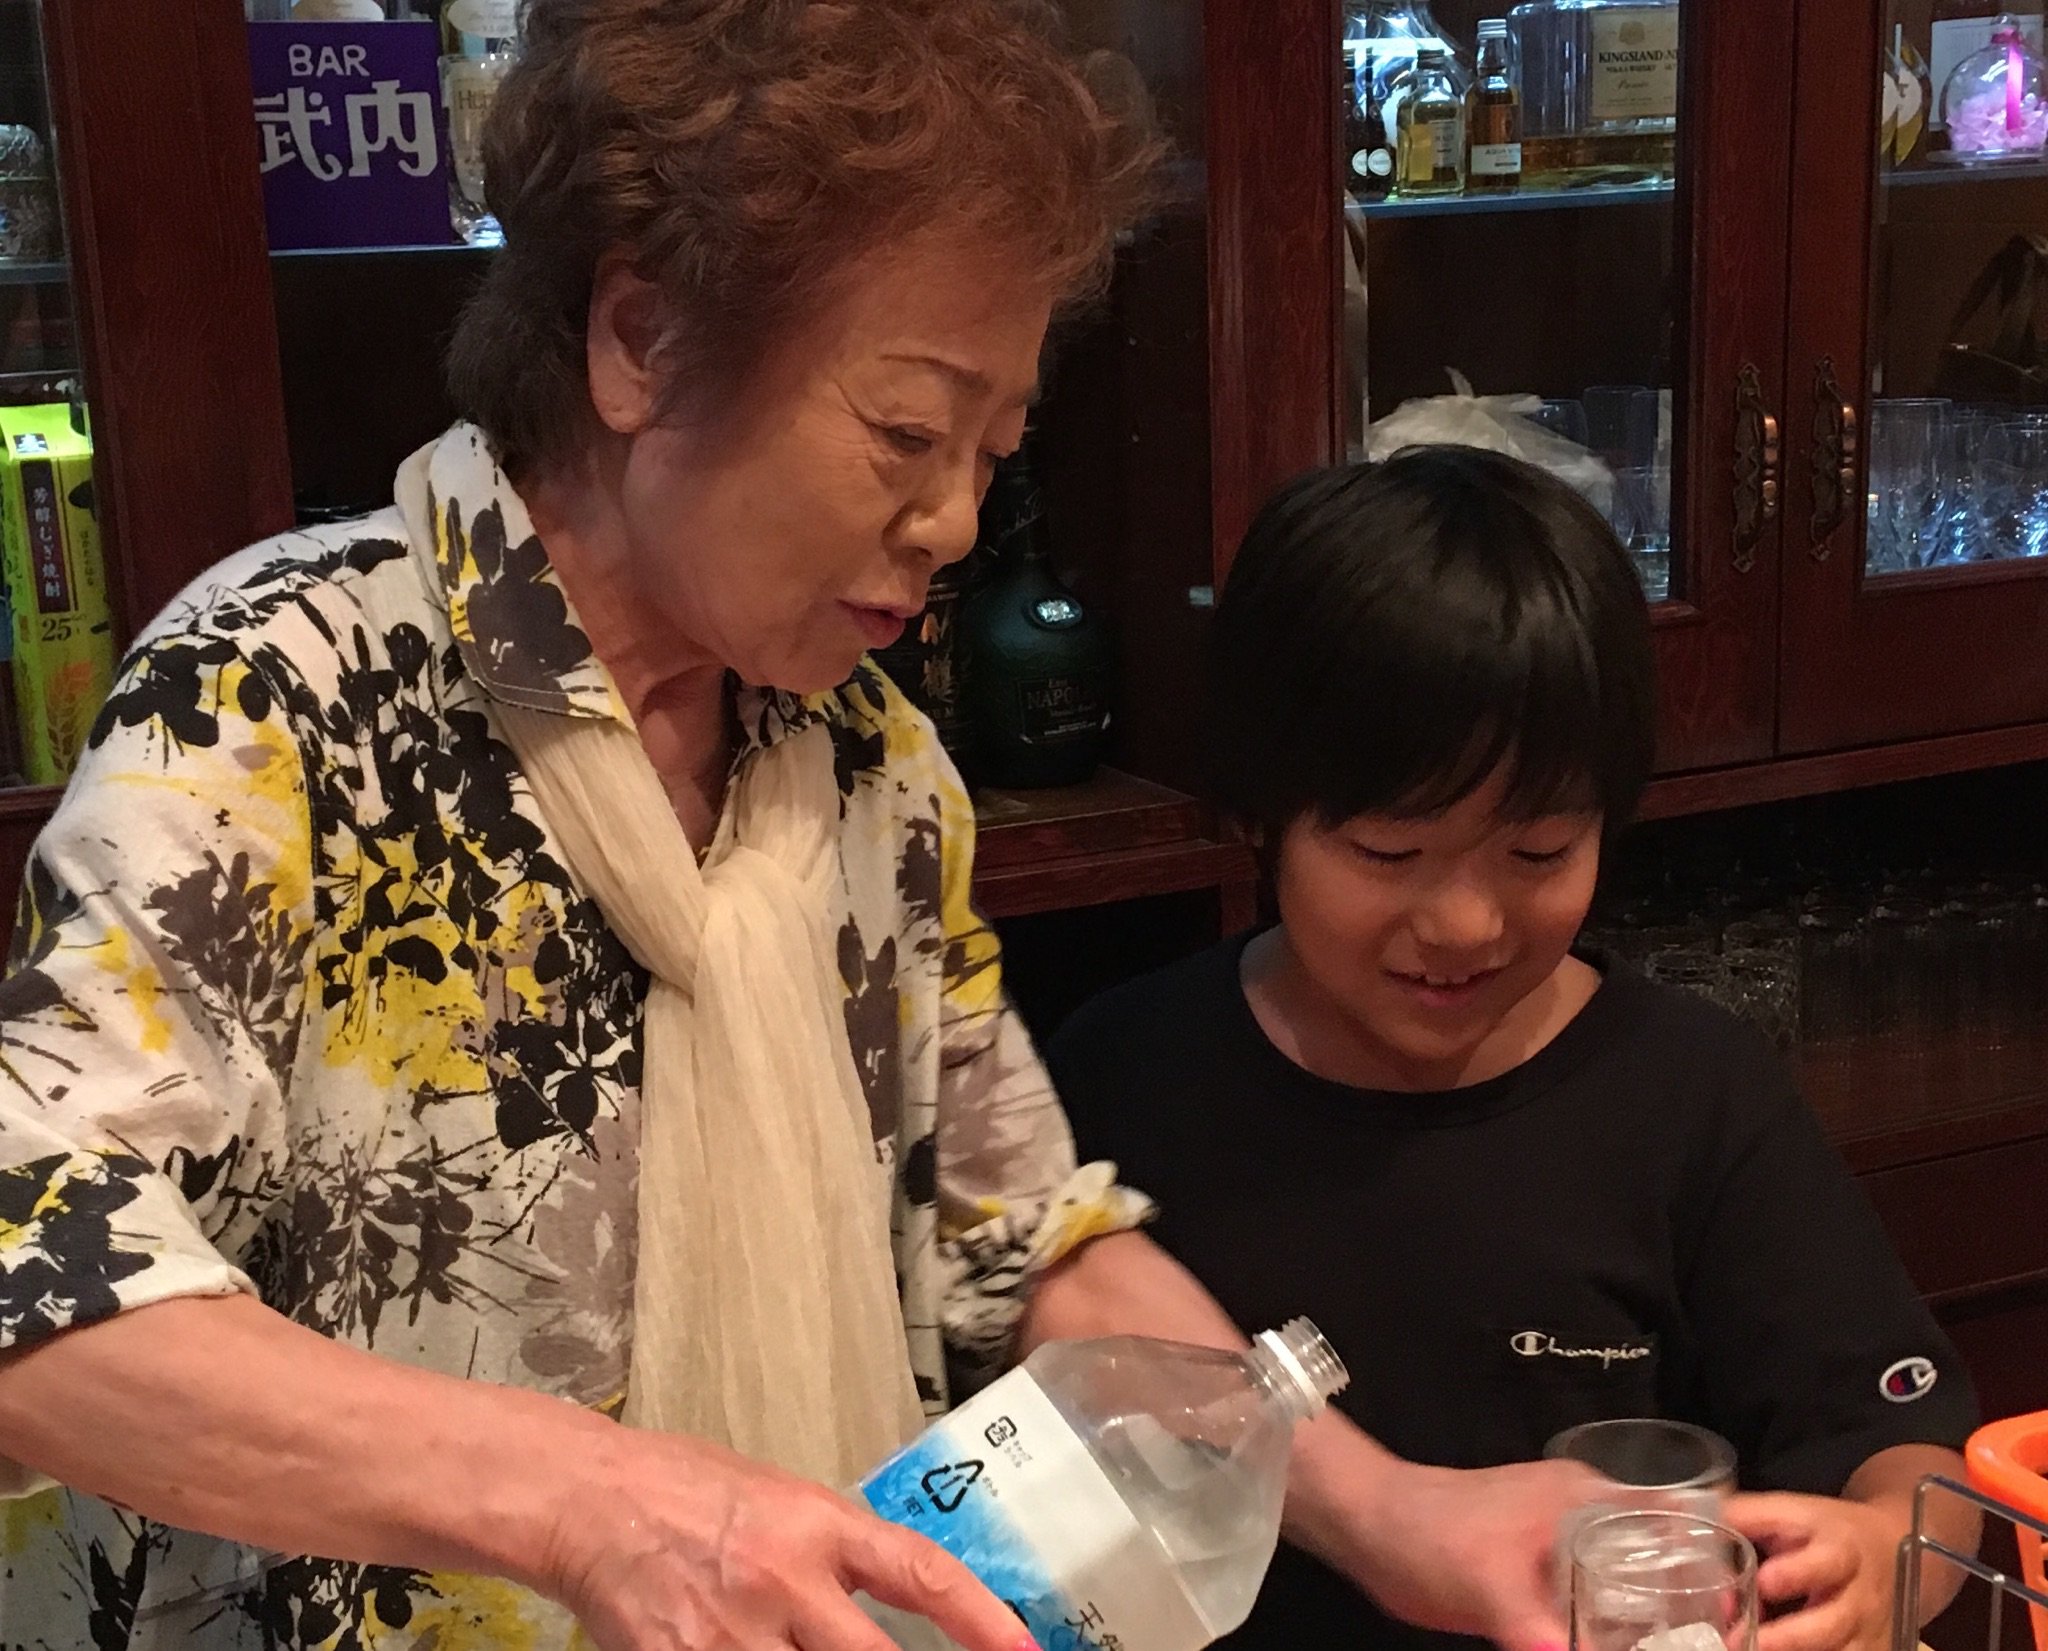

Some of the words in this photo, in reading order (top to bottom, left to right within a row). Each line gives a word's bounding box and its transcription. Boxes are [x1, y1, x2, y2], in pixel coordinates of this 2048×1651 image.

[288, 44, 370, 77] BAR
[1599, 50, 1664, 64] KINGSLAND
[252, 80, 438, 181] 武内
[41, 618, 72, 642] 25
